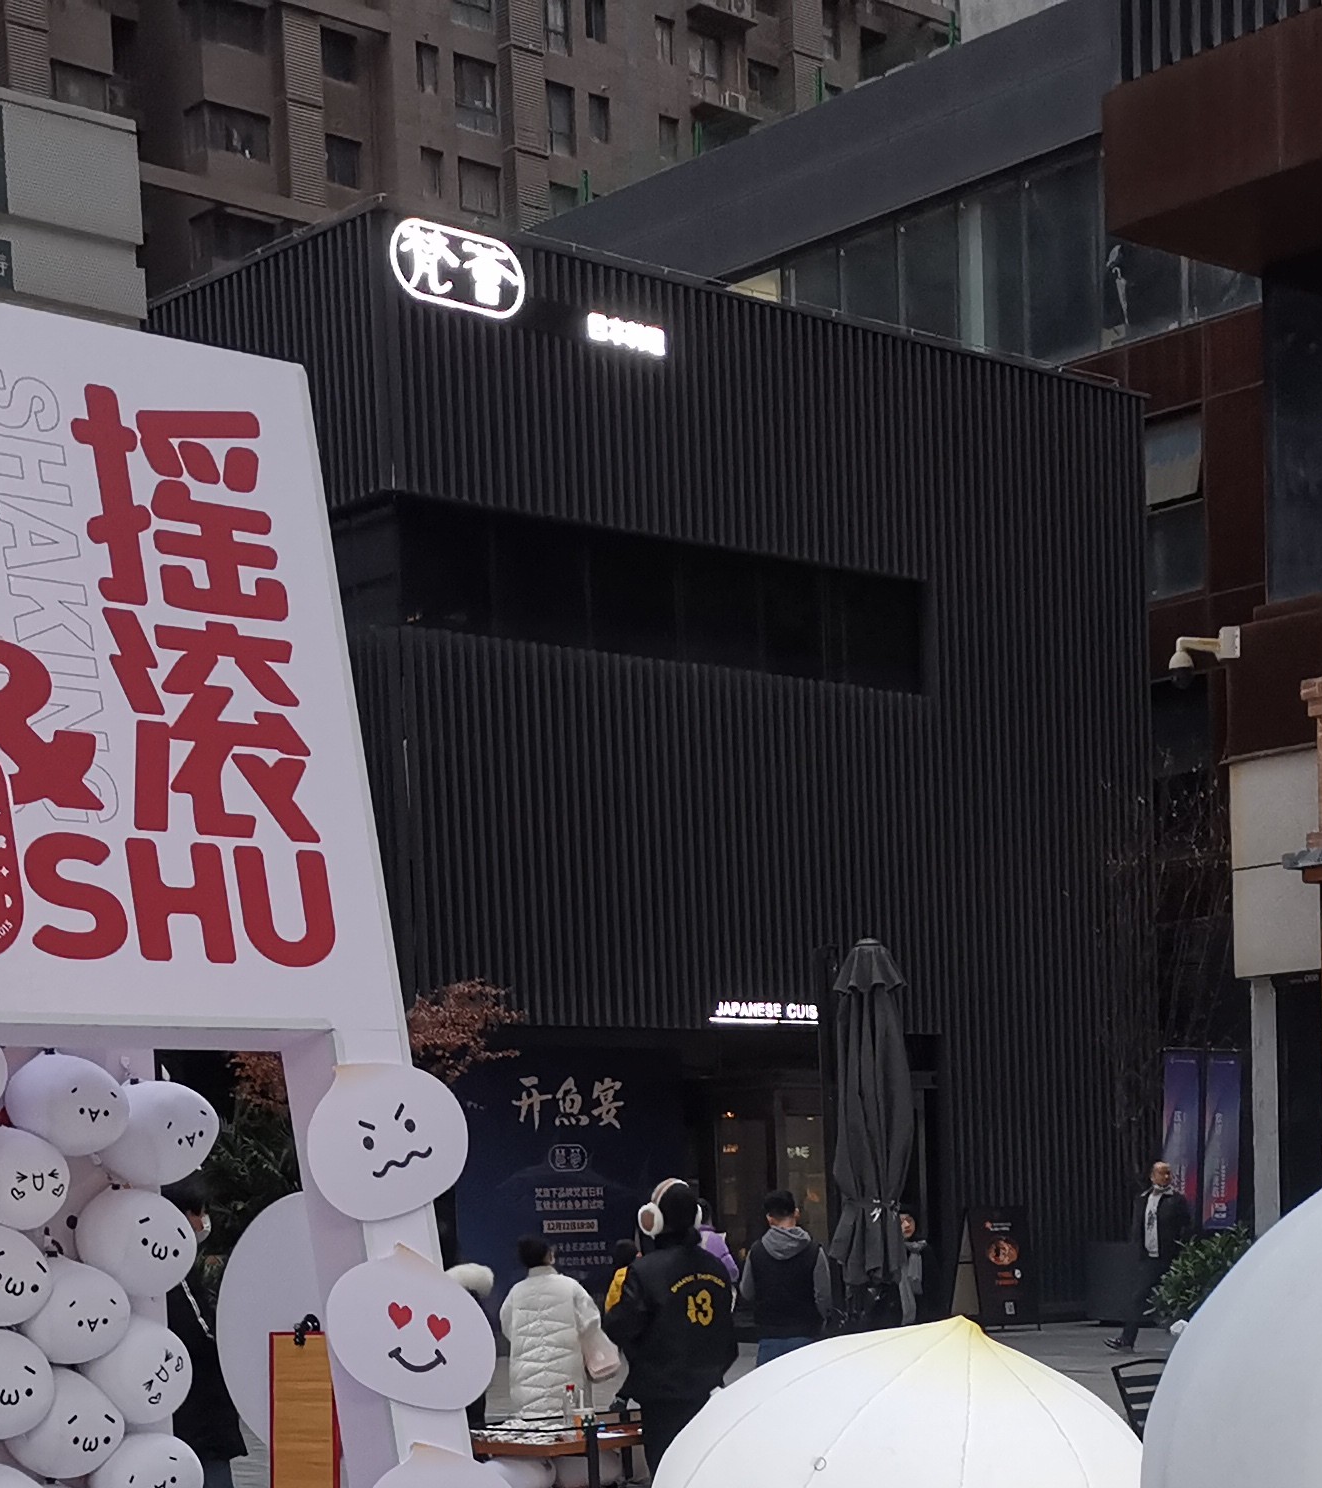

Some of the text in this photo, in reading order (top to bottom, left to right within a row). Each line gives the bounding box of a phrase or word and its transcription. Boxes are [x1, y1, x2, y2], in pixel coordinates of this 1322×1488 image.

[71, 383, 322, 844] 摇滚
[716, 1001, 819, 1020] JAPANESE CUIS
